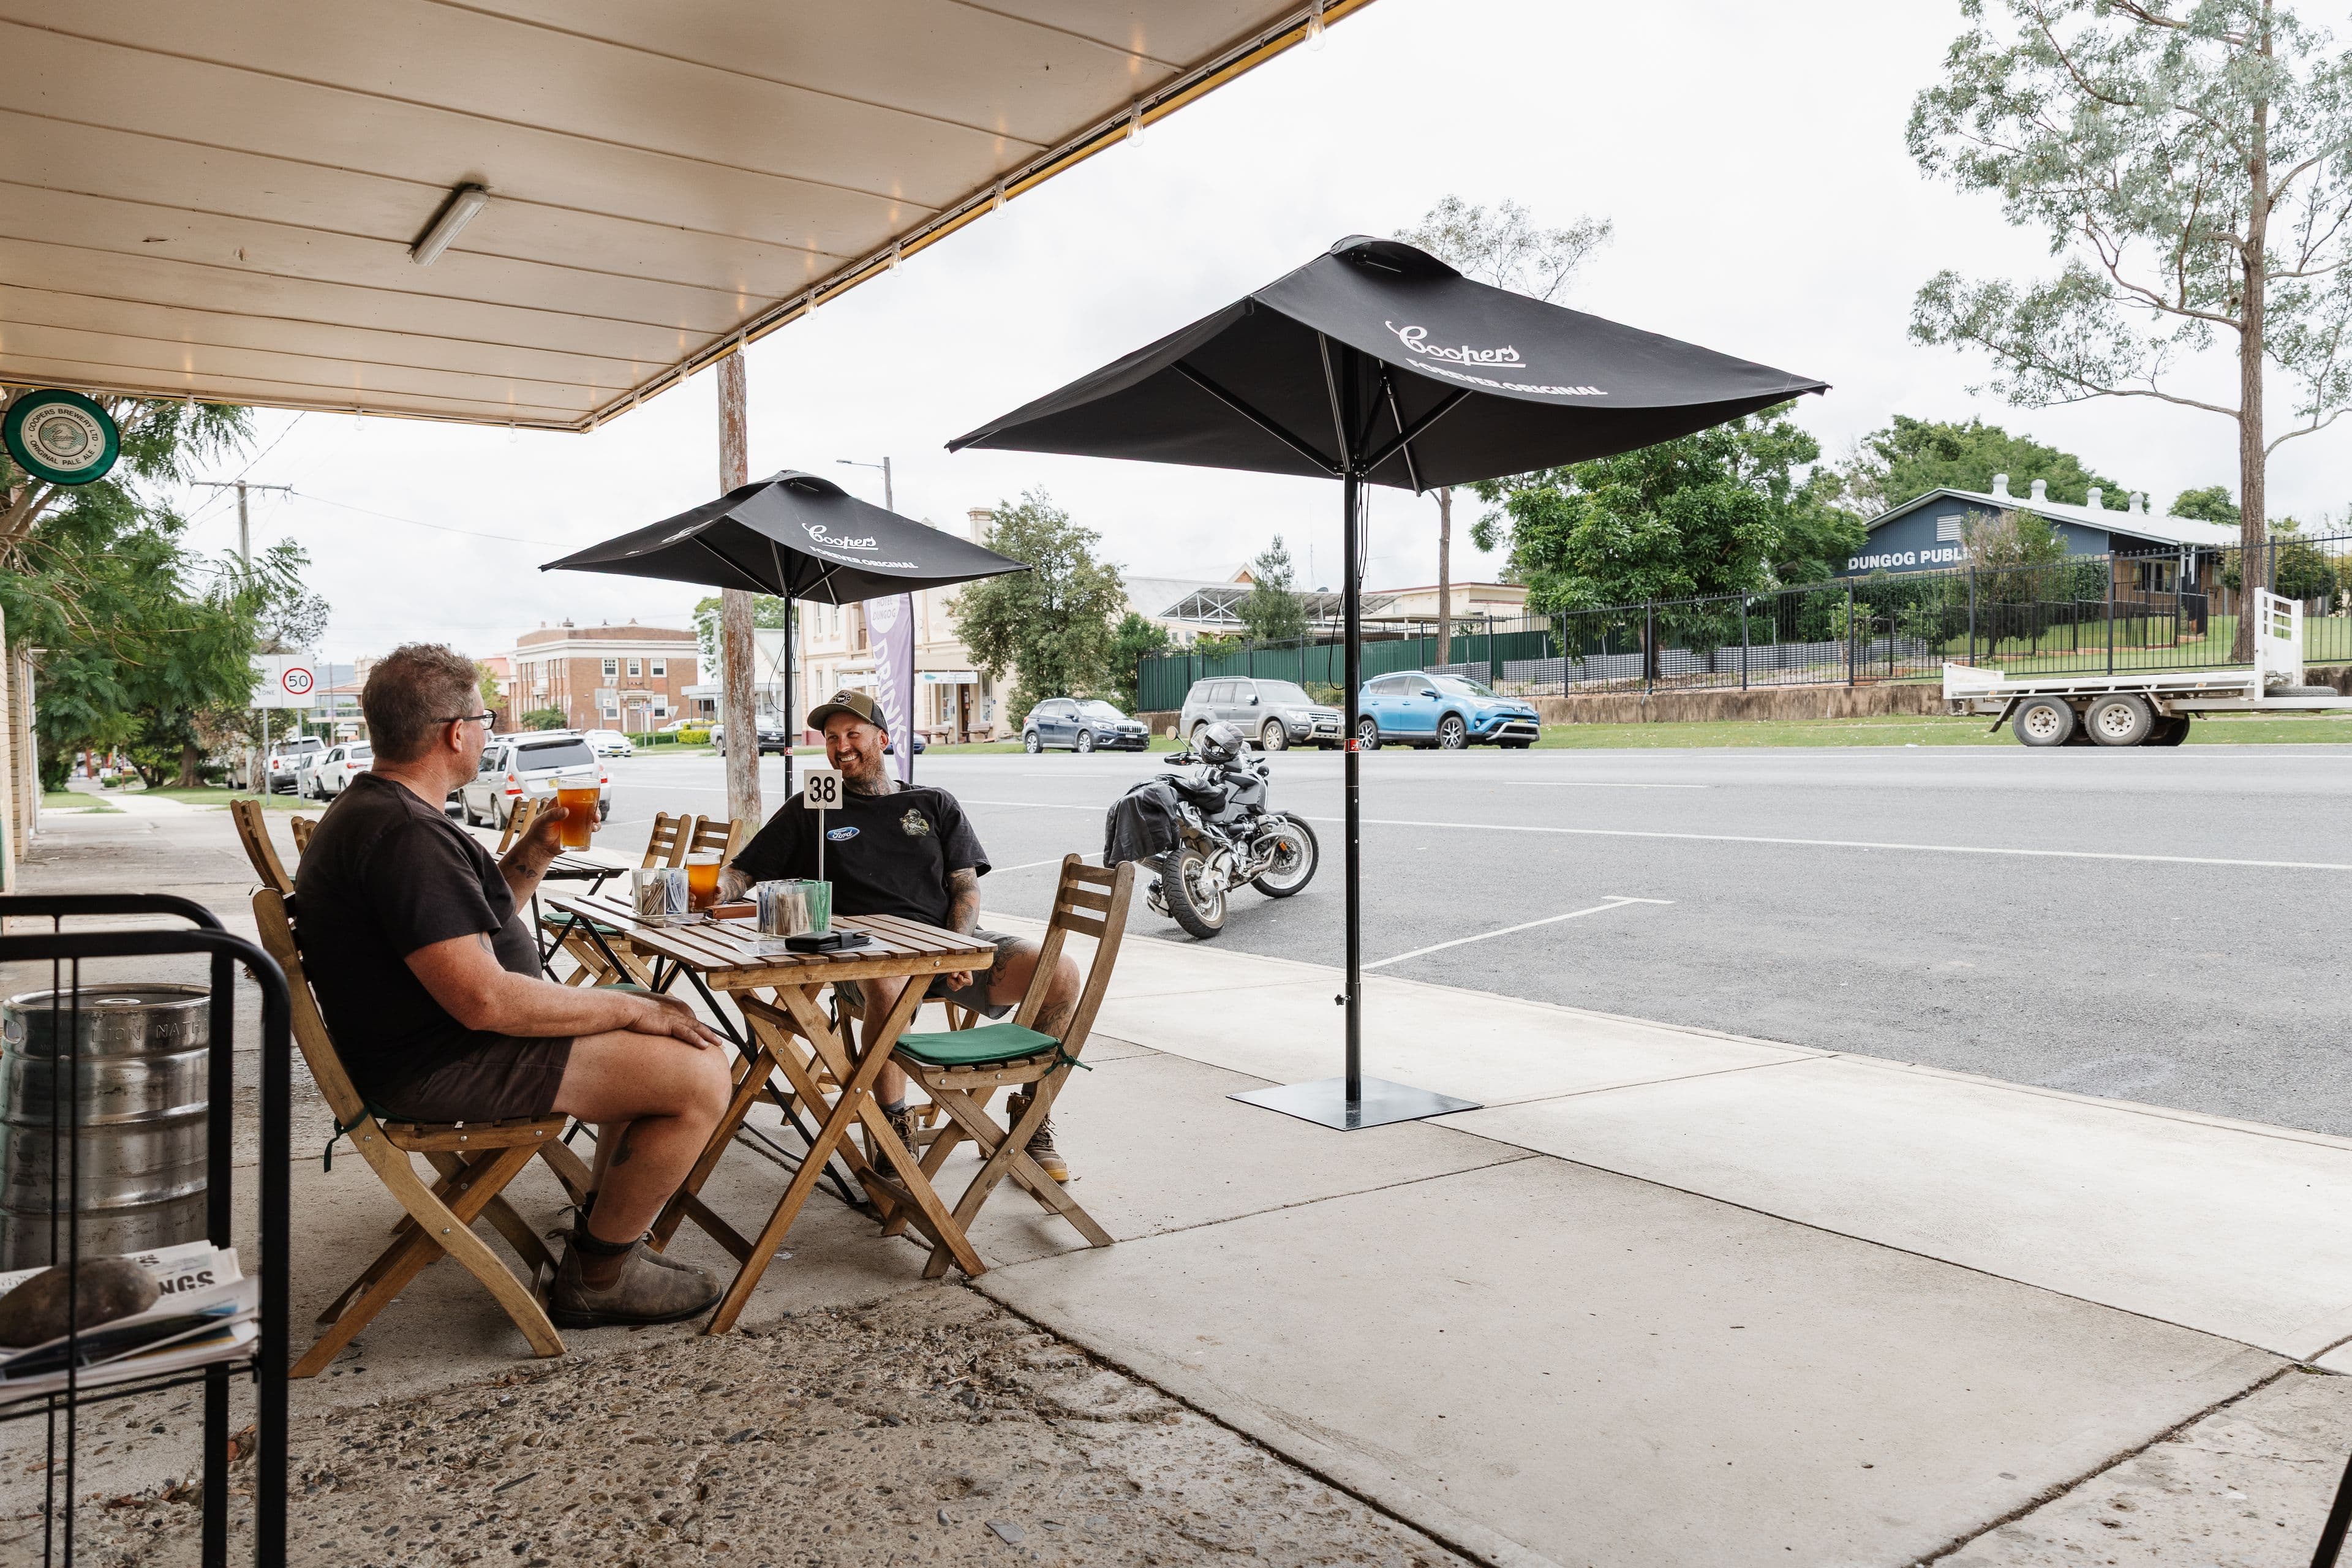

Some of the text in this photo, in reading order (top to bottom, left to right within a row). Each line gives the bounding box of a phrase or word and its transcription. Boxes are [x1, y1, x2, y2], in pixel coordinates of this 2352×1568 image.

[1385, 320, 1521, 366] Coopers
[1405, 358, 1608, 395] FOREVER ORIGINAL
[28, 409, 56, 432] COOPERS
[58, 409, 93, 428] BREWERY
[89, 429, 99, 441] LTD
[30, 440, 58, 464] ORIGINAL
[83, 449, 95, 461] ALE
[801, 522, 876, 550] Coopers
[809, 546, 919, 568] FOREVER ORIGINAL
[1848, 551, 1916, 570] DUNGOG
[872, 608, 896, 620] DUNGOG
[876, 597, 892, 607] HOTEL
[288, 675, 308, 687] 50
[809, 776, 836, 802] 38
[832, 828, 853, 839] Ford
[92, 1018, 208, 1042] LION NATHA
